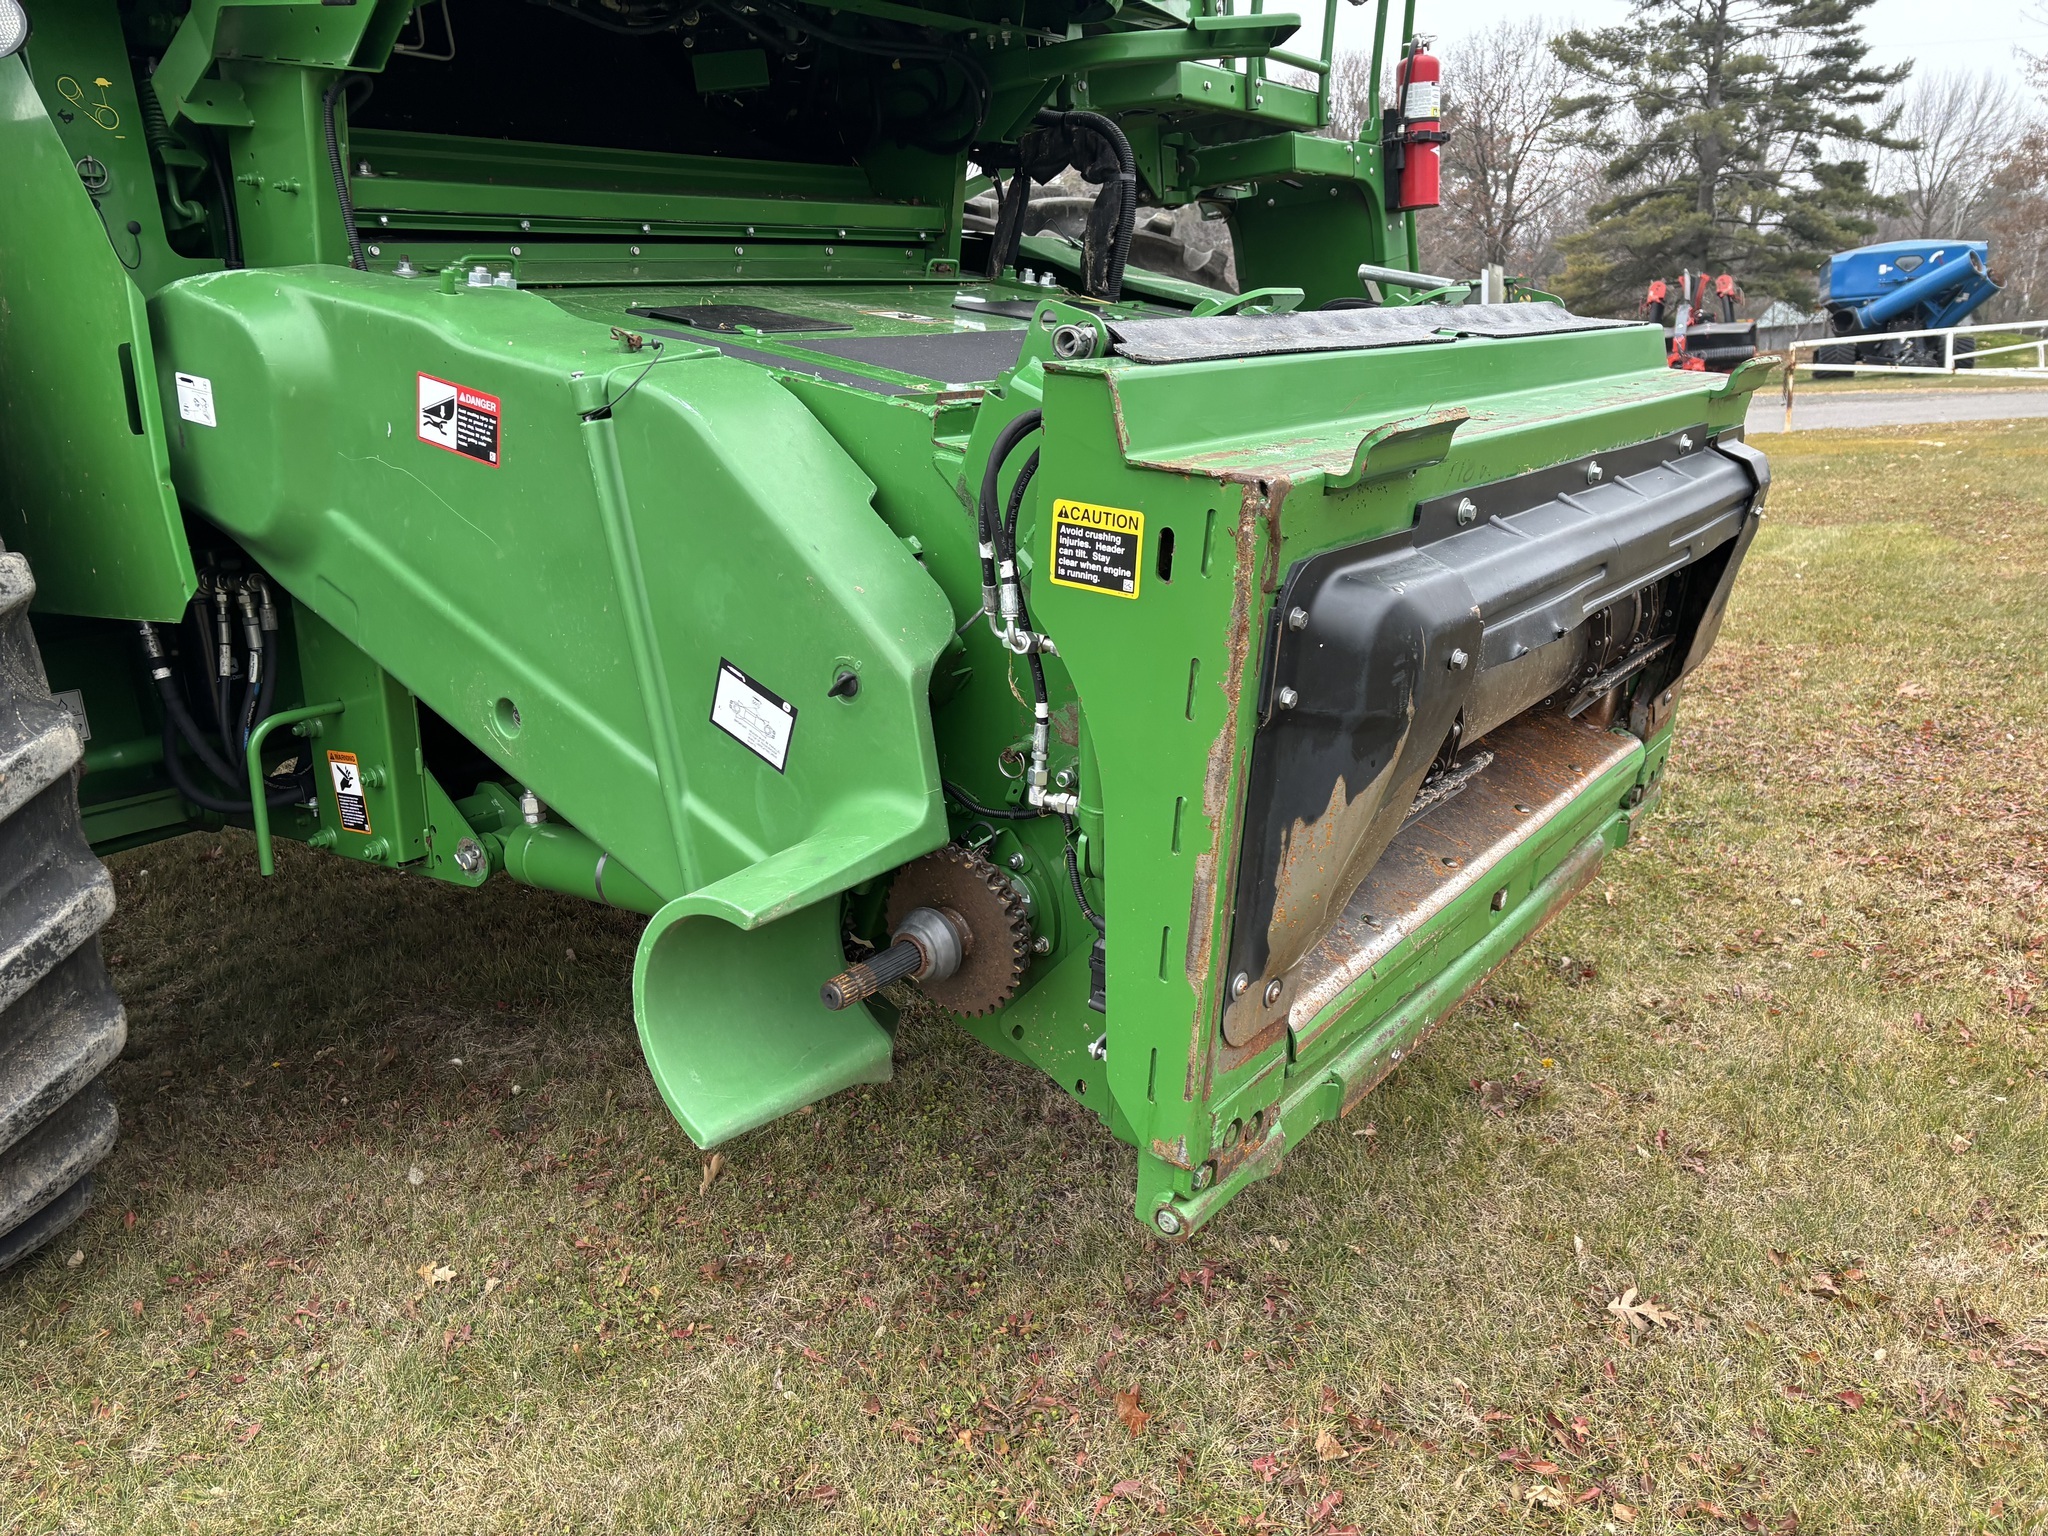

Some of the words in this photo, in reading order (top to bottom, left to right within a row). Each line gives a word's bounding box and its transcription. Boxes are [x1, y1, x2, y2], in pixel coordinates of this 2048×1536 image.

[466, 394, 496, 412] DANGER
[1071, 507, 1139, 530] CAUTION
[1060, 525, 1083, 536] Avoid
[1085, 531, 1121, 545] crushing
[1060, 536, 1091, 549] injuries.
[1096, 542, 1125, 555] Header
[1059, 547, 1073, 556] can
[1075, 549, 1088, 559] tilt.
[1092, 552, 1110, 564] Stay
[1058, 566, 1065, 575] is
[1067, 569, 1100, 584] running.
[1059, 557, 1078, 567] clear
[1080, 561, 1101, 572] when
[1103, 566, 1131, 577] engine
